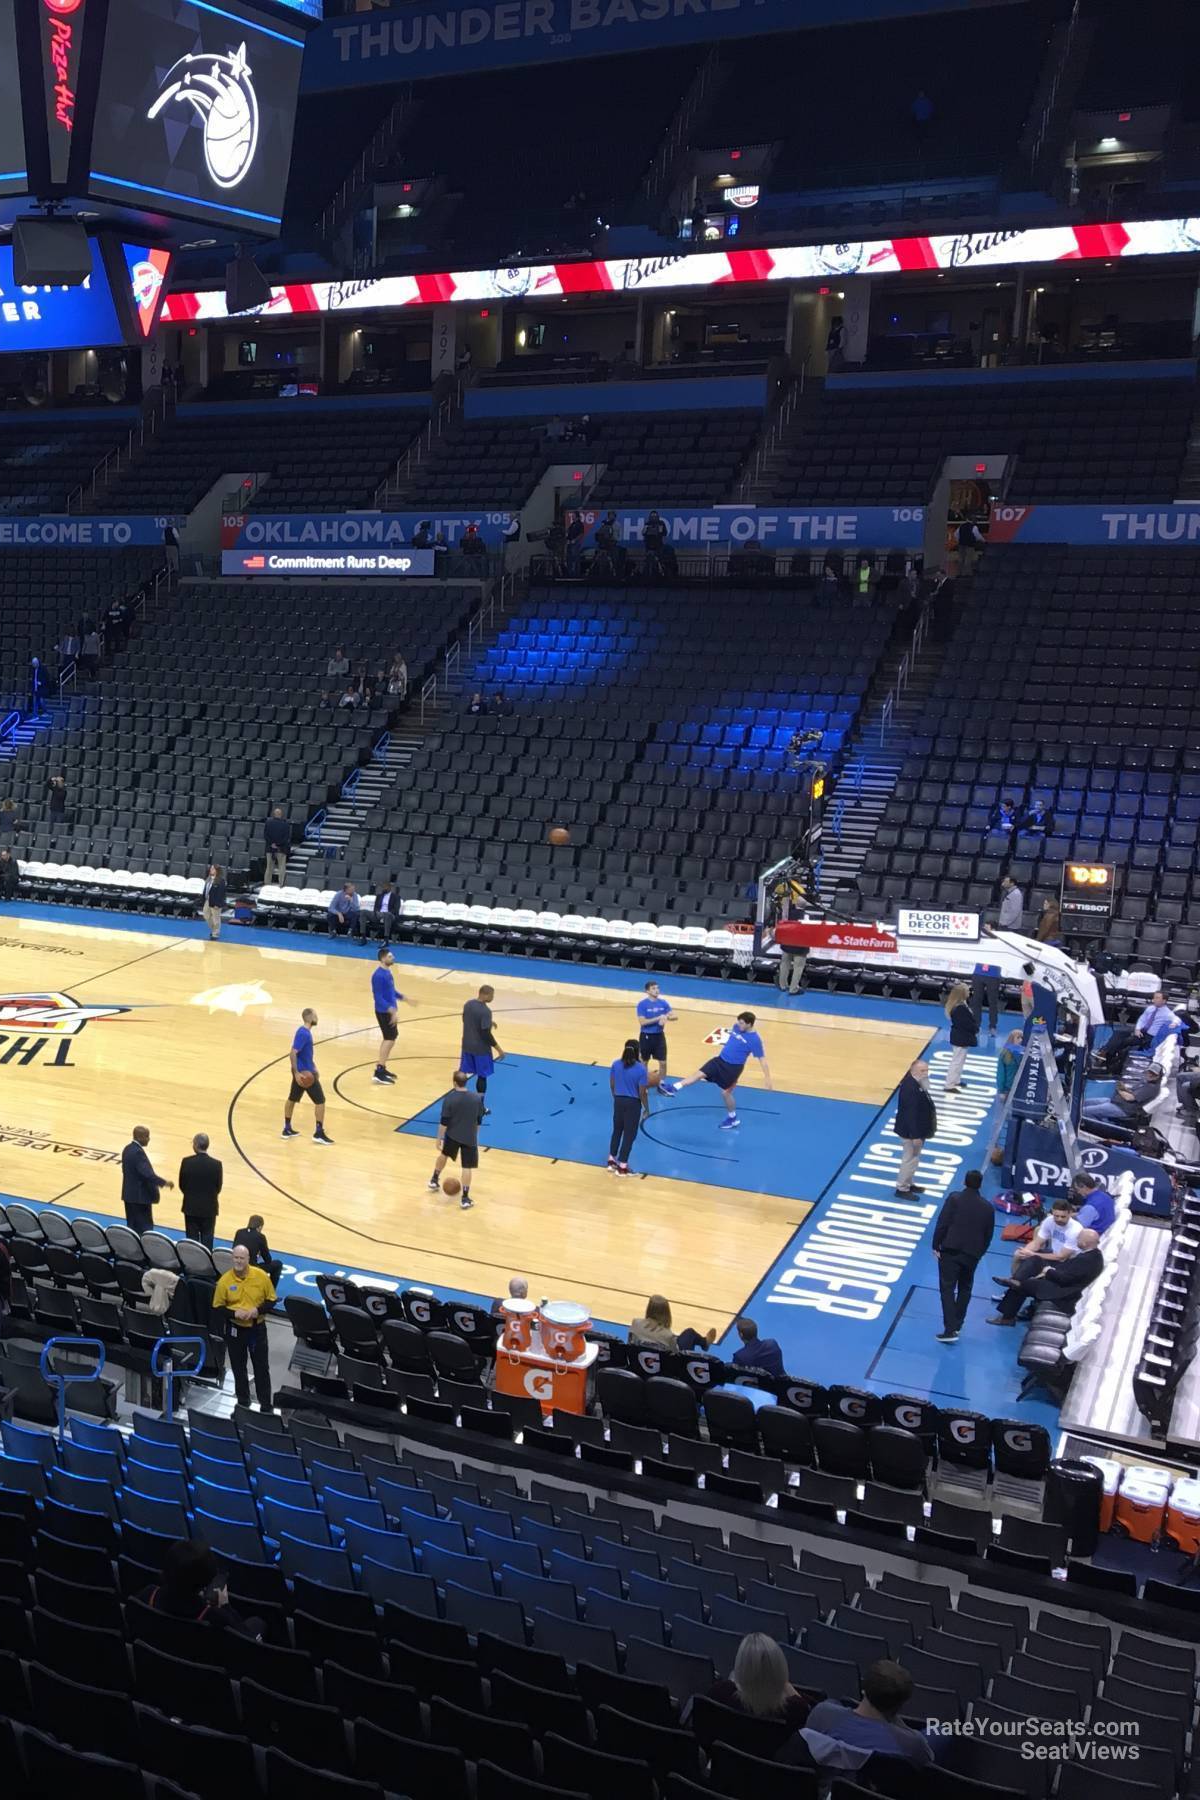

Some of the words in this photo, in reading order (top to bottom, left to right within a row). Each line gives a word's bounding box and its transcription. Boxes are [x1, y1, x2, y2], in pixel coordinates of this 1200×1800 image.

[332, 8, 555, 62] THUNDER
[48, 18, 72, 82] Pizza
[54, 84, 75, 132] Hut
[439, 324, 448, 360] 207
[149, 342, 158, 376] 206
[222, 516, 245, 528] 105
[485, 513, 511, 525] 105
[892, 508, 923, 522] 106
[994, 507, 1026, 521] 107
[96, 522, 132, 544] TO
[245, 520, 406, 543] OKLAHOMA
[730, 515, 778, 541] OF
[788, 515, 858, 540] THE
[268, 555, 345, 569] Commitment
[347, 555, 376, 569] Runs
[378, 555, 412, 572] Deep
[908, 912, 950, 922] FLOOR
[1076, 904, 1109, 912] TISSOT
[908, 920, 950, 930] DECOR
[766, 1193, 938, 1321] THUNDER
[324, 1284, 346, 1304] G
[365, 1296, 387, 1316] G
[409, 1300, 431, 1322] G
[454, 1311, 476, 1332] G
[510, 1319, 521, 1333] G
[555, 1331, 567, 1344] G
[639, 1351, 661, 1374] G
[686, 1361, 711, 1384] G
[523, 1368, 554, 1400] G
[786, 1385, 813, 1408] G
[839, 1396, 866, 1418] G
[894, 1405, 922, 1428] G
[950, 1419, 977, 1444] G
[1003, 1430, 1032, 1452] G
